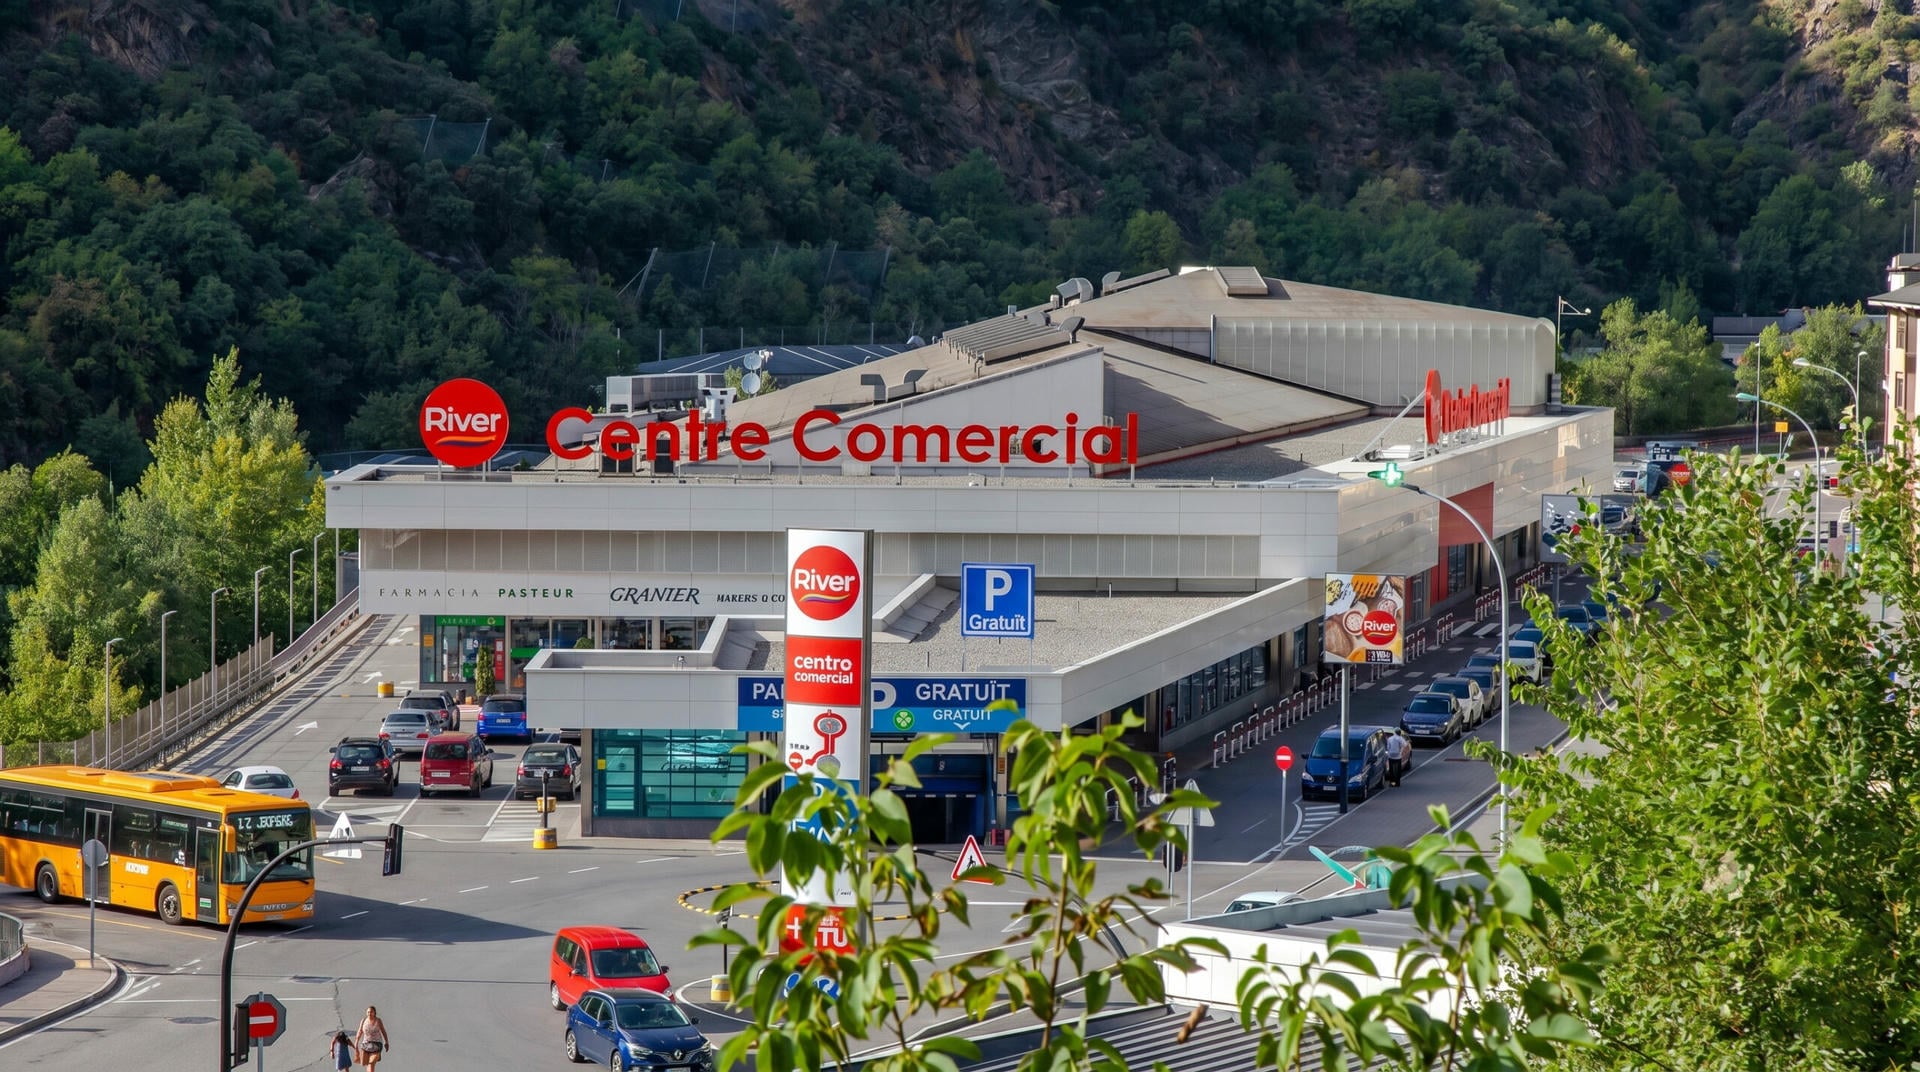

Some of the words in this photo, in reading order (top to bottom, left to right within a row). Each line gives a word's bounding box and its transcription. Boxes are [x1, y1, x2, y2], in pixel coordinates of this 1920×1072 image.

[425, 407, 501, 433] River
[545, 406, 770, 462] Centre
[793, 409, 1139, 464] Comercial
[794, 568, 856, 592] River
[379, 588, 479, 598] FARMACIA
[498, 588, 574, 598] PASTEUR
[610, 587, 700, 605] GRANIER
[716, 594, 758, 603] MAKERS
[985, 569, 1013, 612] P
[969, 614, 1026, 631] Gratuït
[1363, 620, 1396, 632] River
[794, 655, 853, 671] centro
[794, 671, 853, 685] comercial
[752, 683, 784, 700] PA
[915, 680, 1011, 701] GRATUÏT
